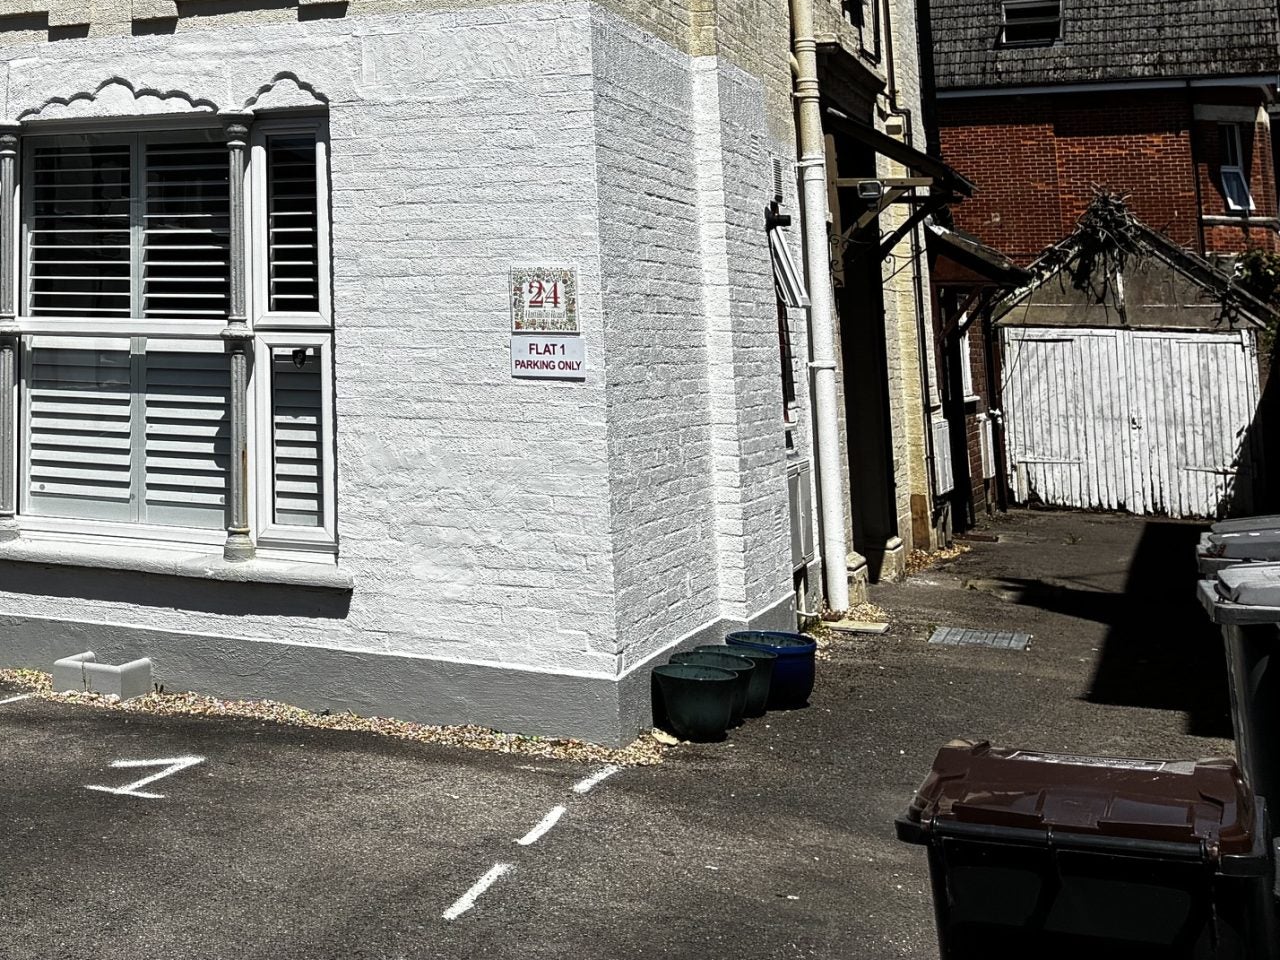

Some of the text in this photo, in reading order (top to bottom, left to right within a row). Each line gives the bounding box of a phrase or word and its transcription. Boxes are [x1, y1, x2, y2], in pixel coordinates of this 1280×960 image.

[528, 280, 561, 308] 24
[529, 343, 566, 355] FLAT 1
[514, 360, 582, 371] PARKING ONLY
